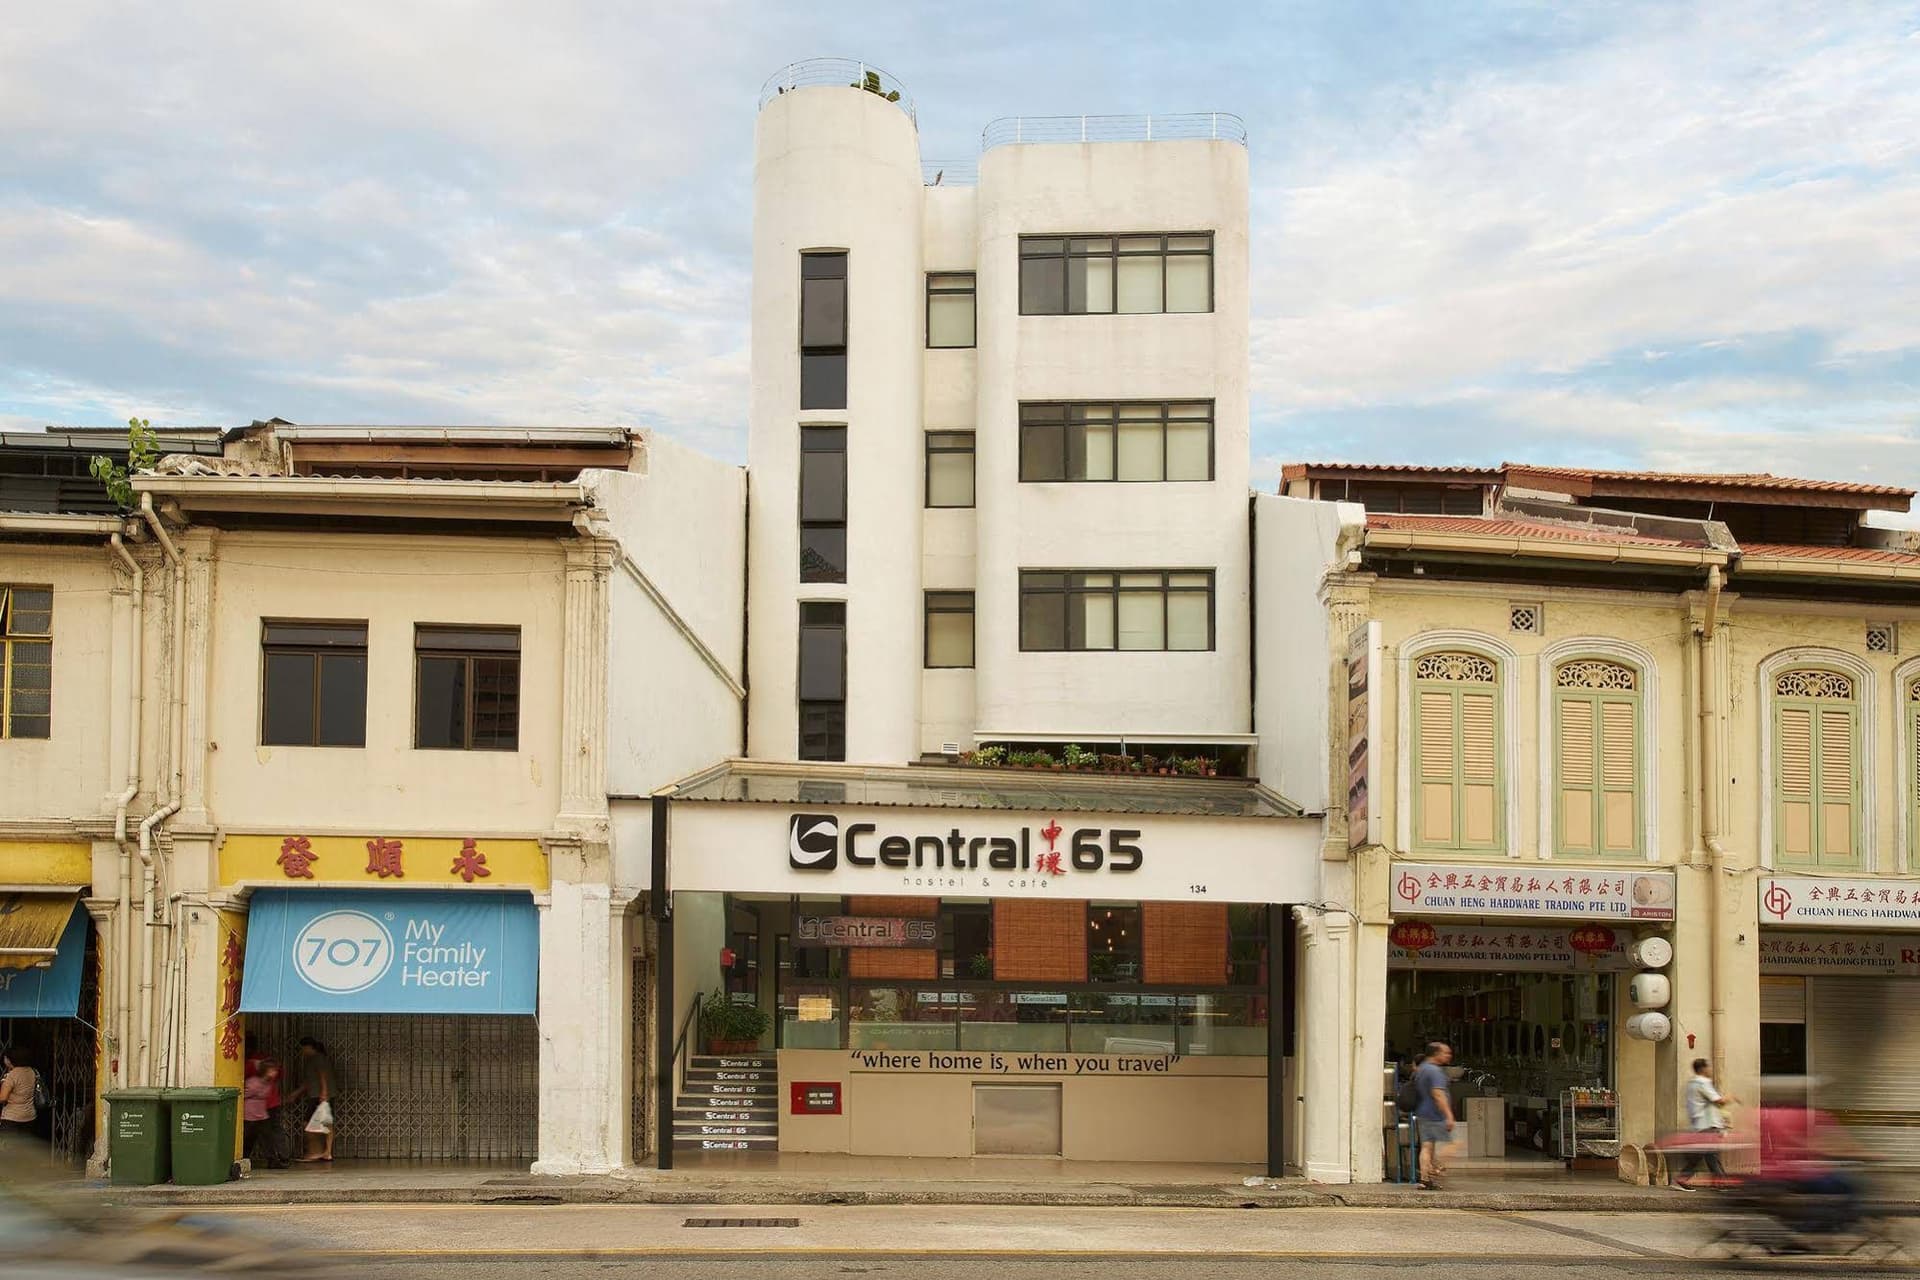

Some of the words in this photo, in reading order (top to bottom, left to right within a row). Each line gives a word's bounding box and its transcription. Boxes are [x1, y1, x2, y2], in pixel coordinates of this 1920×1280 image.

[845, 823, 1030, 870] Central
[1071, 828, 1144, 872] 65
[903, 877, 965, 887] hostel
[982, 878, 990, 887] &
[1189, 885, 1207, 894] 134
[1424, 895, 1456, 907] CHUAN
[1460, 897, 1485, 908] HENG
[1490, 898, 1541, 910] HARDWARE
[1545, 899, 1585, 912] TRADING
[1589, 901, 1606, 912] PTE
[1610, 902, 1627, 912] LTD
[1797, 906, 1835, 917] CHUAN
[1838, 908, 1868, 918] HENG
[405, 919, 445, 945] My
[820, 920, 892, 939] Central
[906, 920, 937, 940] 65
[306, 938, 382, 967] 707
[403, 941, 487, 969] Family
[1433, 950, 1487, 960] HARDWARE
[1488, 951, 1531, 961] TRADING
[1533, 952, 1551, 961] PTE
[1552, 952, 1571, 962] LTD
[1763, 955, 1817, 965] HARDWARE
[1818, 957, 1860, 966] TRADING
[402, 966, 491, 987] Heater
[929, 1052, 983, 1070] home
[990, 1053, 1009, 1073] is,
[1018, 1054, 1068, 1072] when
[1075, 1059, 1110, 1075] you
